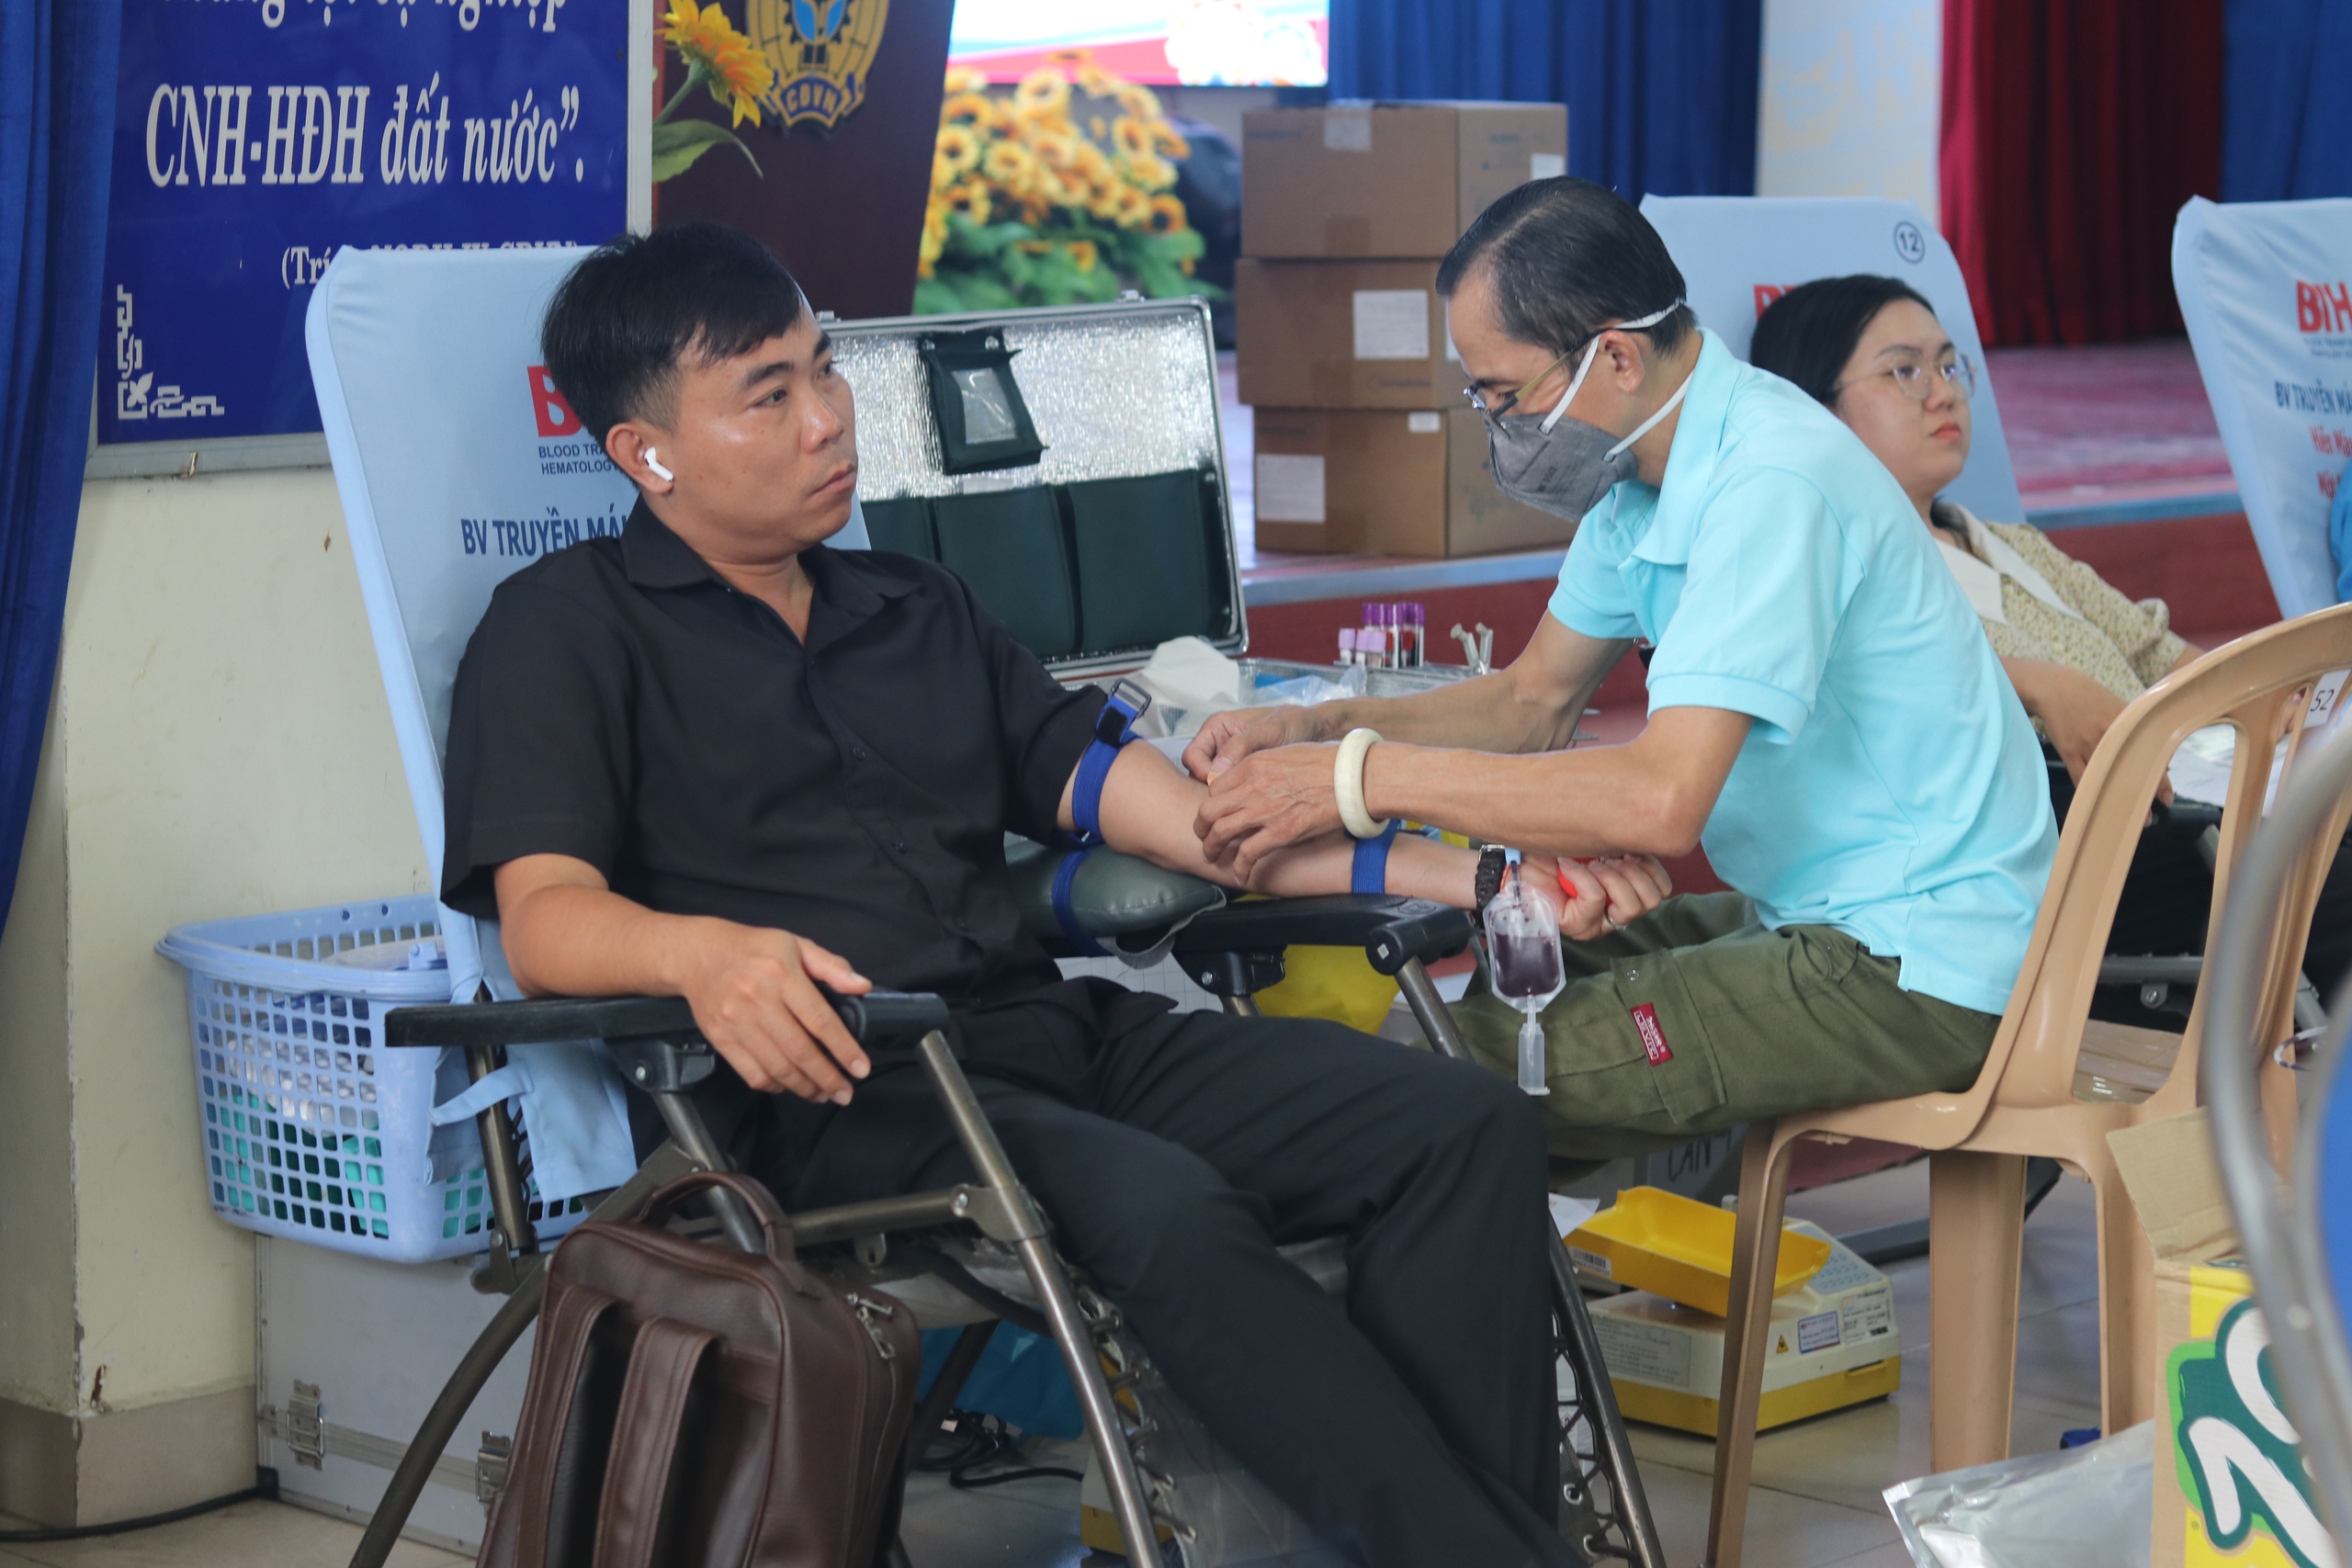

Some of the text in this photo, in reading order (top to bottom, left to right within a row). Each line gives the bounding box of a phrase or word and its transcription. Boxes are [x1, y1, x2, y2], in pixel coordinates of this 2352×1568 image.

[146, 83, 370, 187] CNH-HĐH
[379, 71, 451, 185] đất
[1900, 231, 1920, 253] 12
[538, 445, 581, 458] BLOOD
[460, 502, 628, 557] BV TRUYỀN MÁ
[2310, 689, 2335, 712] 52
